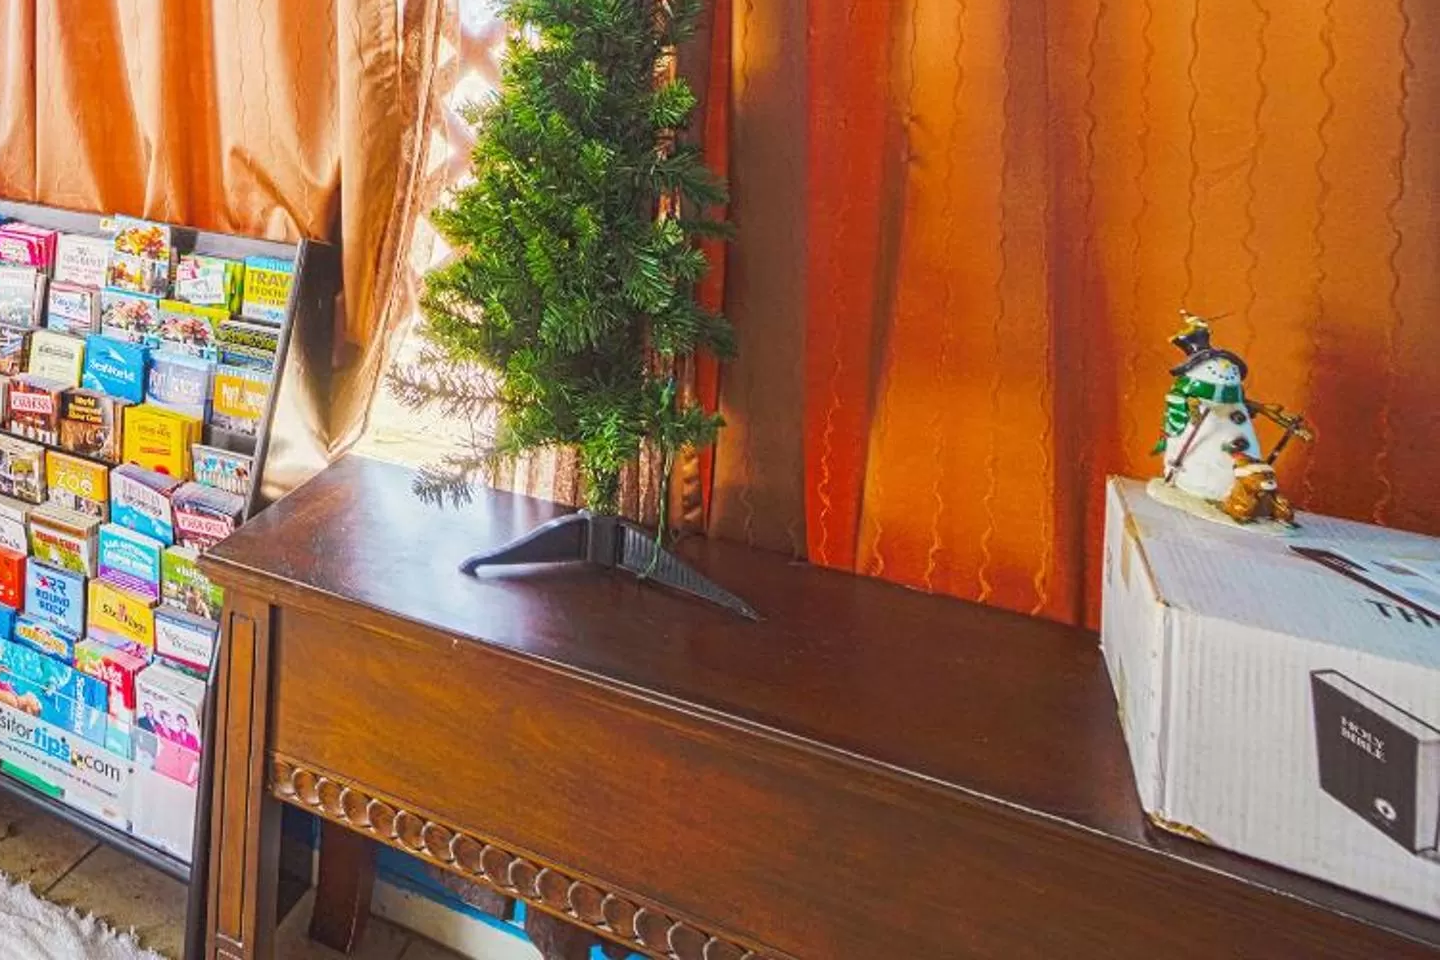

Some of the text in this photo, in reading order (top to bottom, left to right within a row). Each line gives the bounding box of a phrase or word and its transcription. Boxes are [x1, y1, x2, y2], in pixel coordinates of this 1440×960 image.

[35, 588, 71, 608] ROUND
[39, 600, 67, 619] ROCK
[1363, 598, 1433, 628] TH
[1340, 715, 1385, 750] HOLY
[1340, 726, 1387, 763] BIBLE
